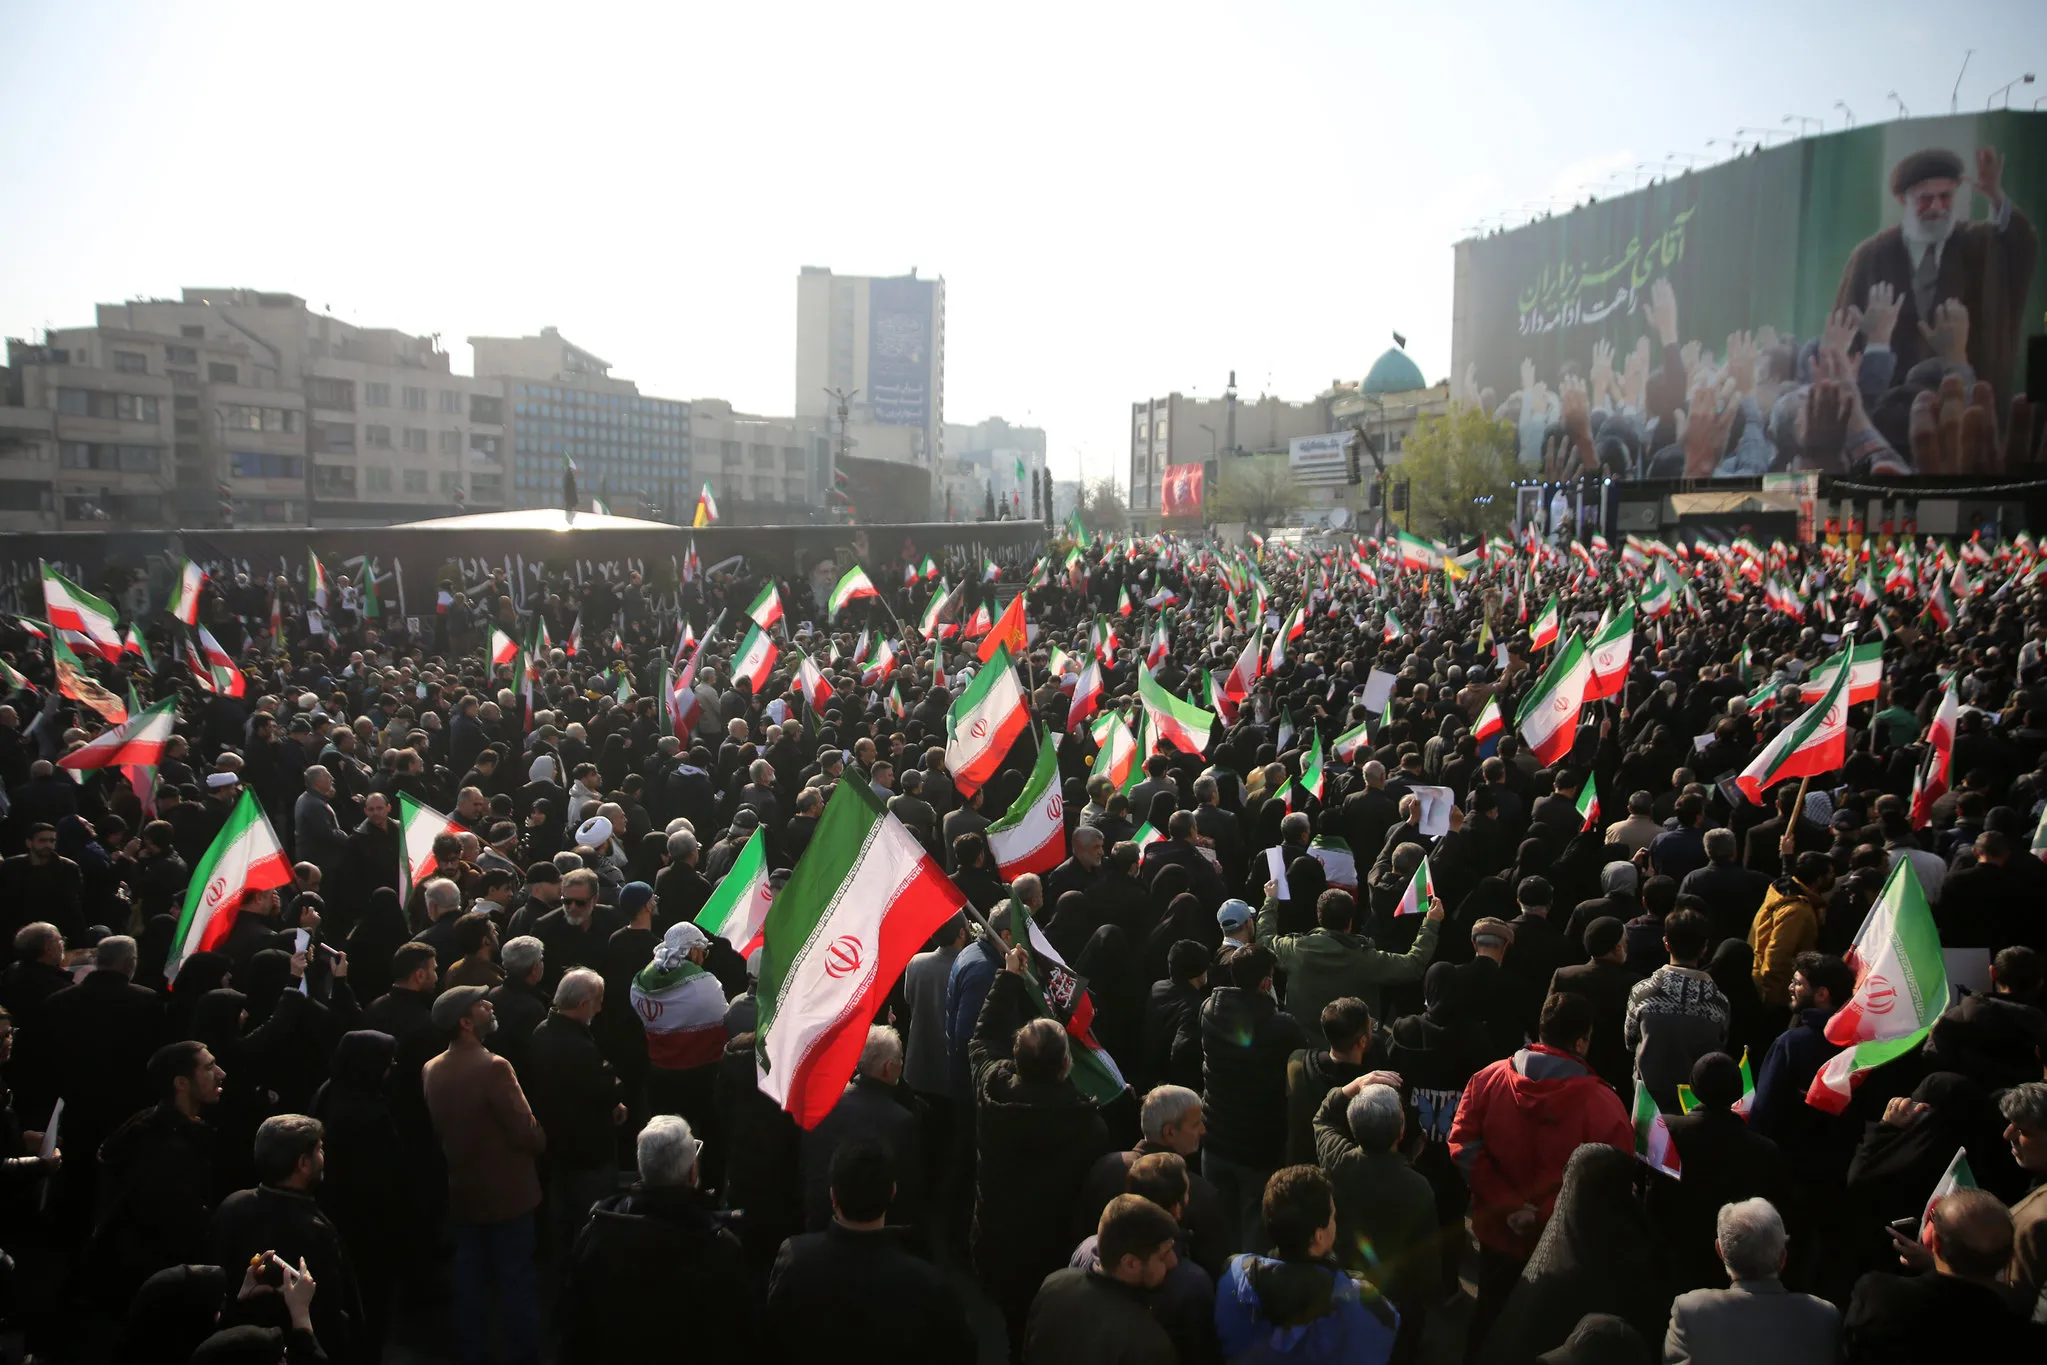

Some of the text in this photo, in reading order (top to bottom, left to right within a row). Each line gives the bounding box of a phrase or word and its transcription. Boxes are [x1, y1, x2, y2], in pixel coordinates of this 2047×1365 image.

[1518, 205, 1697, 313] آقای عزیز ایران
[1517, 286, 1638, 336] راهت ادامه دارد
